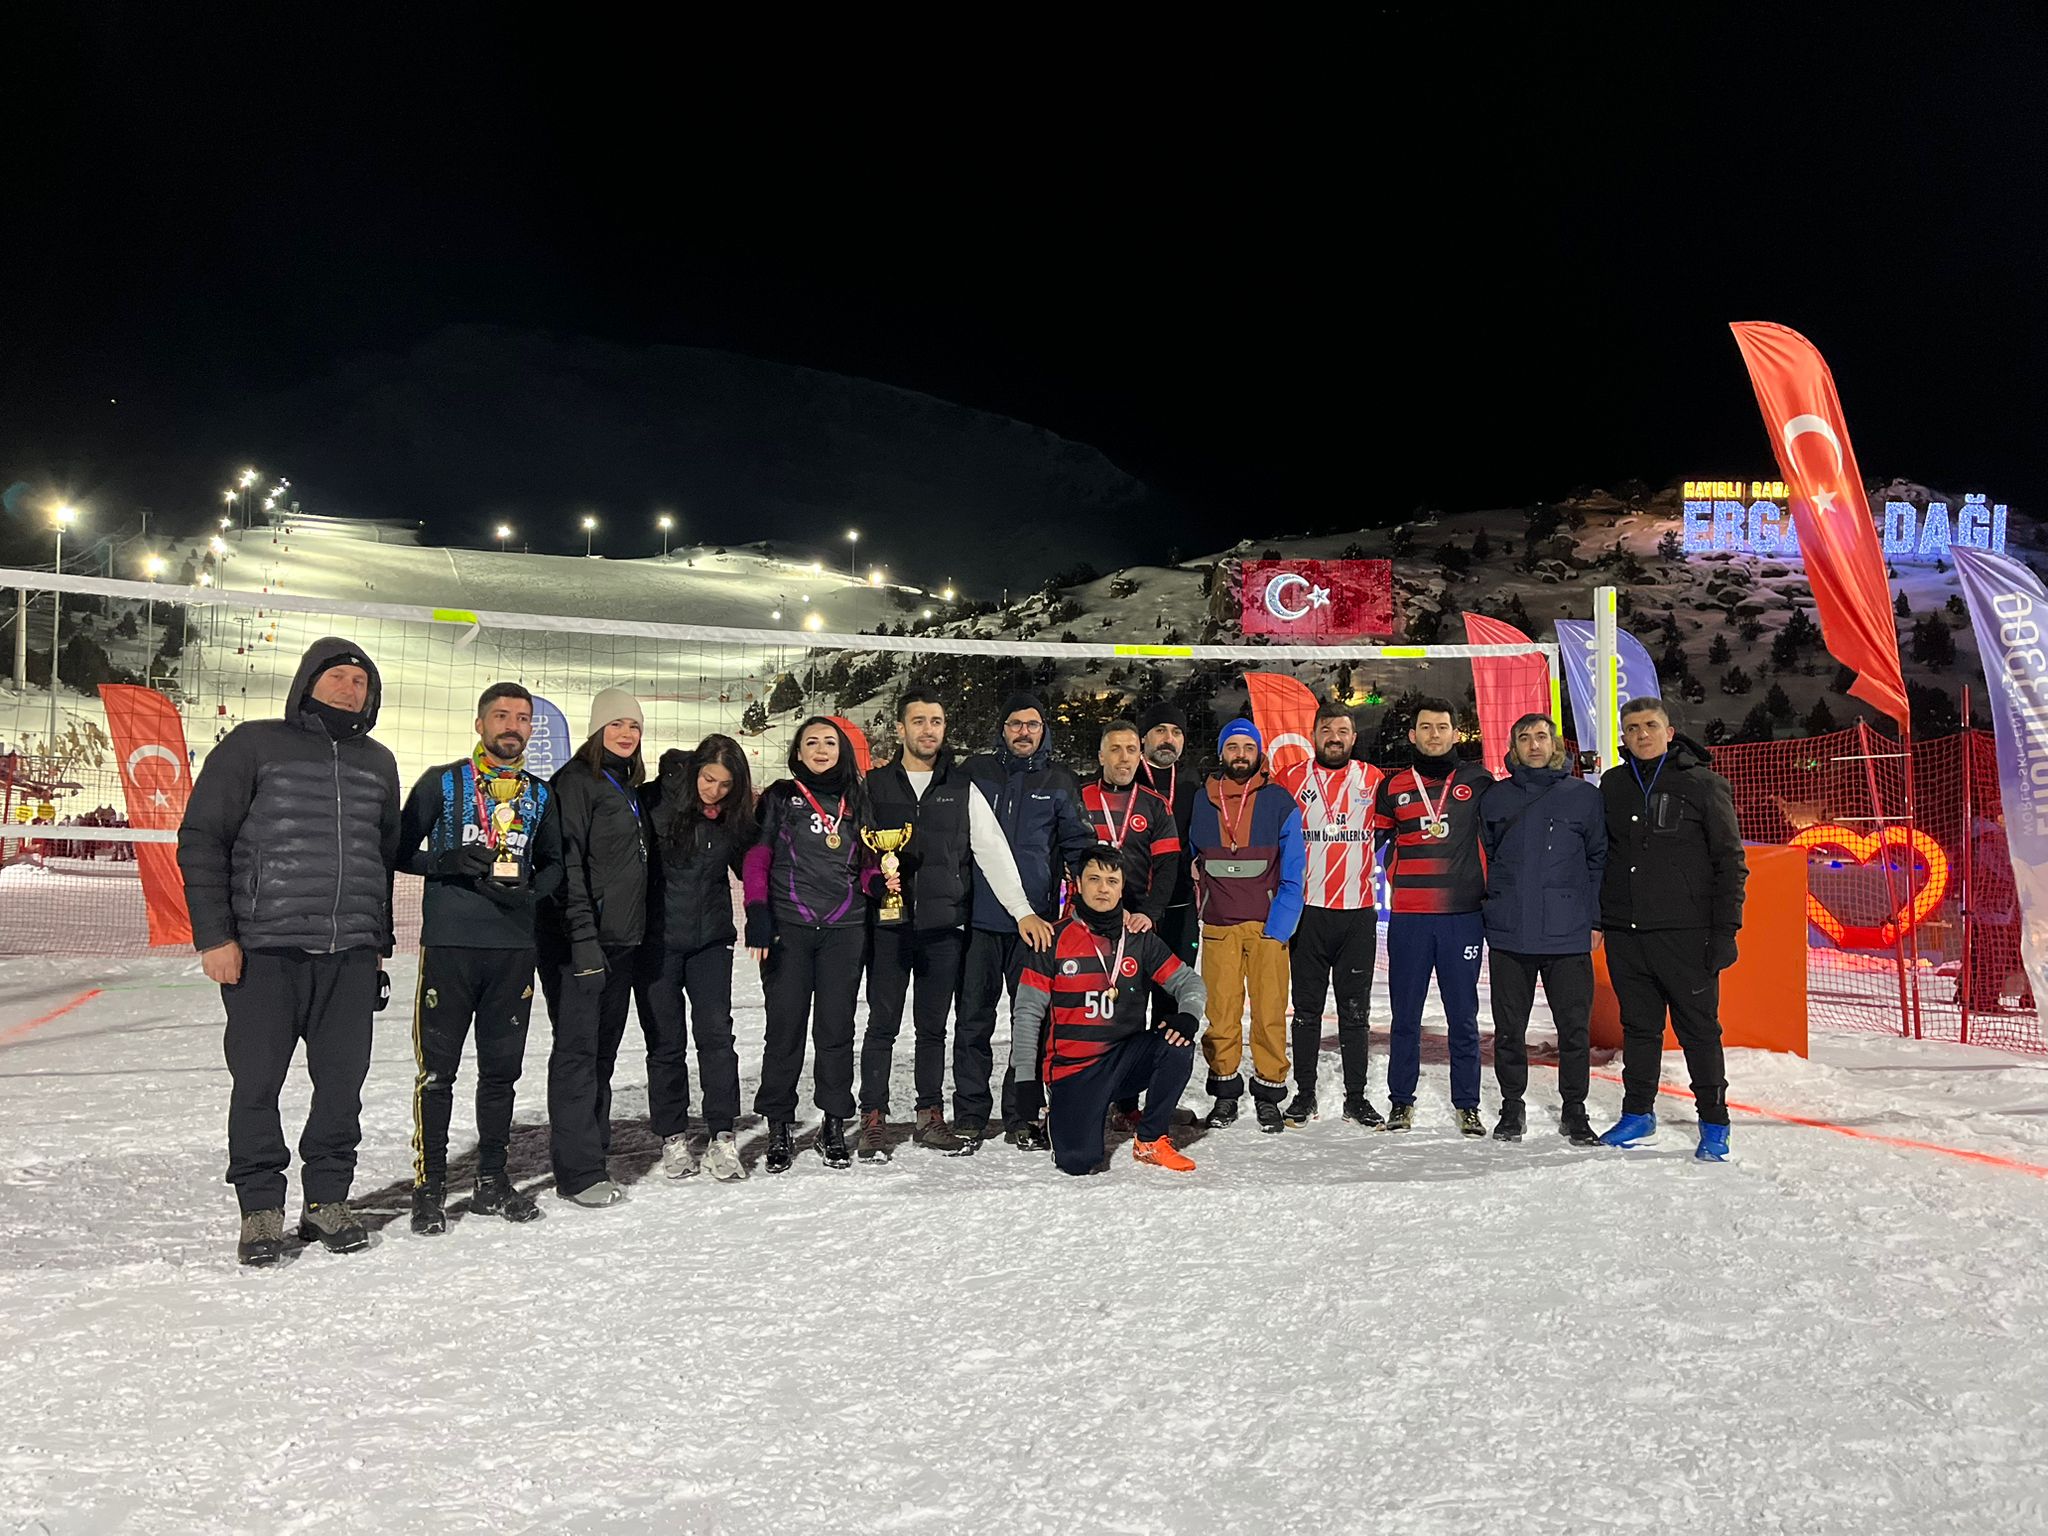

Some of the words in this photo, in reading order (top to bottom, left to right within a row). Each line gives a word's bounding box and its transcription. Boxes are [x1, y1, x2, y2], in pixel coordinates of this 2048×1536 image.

[1683, 481, 1742, 498] HAYIRLI
[1884, 493, 2008, 555] DAĞI
[1463, 945, 1479, 960] 55
[1085, 990, 1114, 1019] 50
